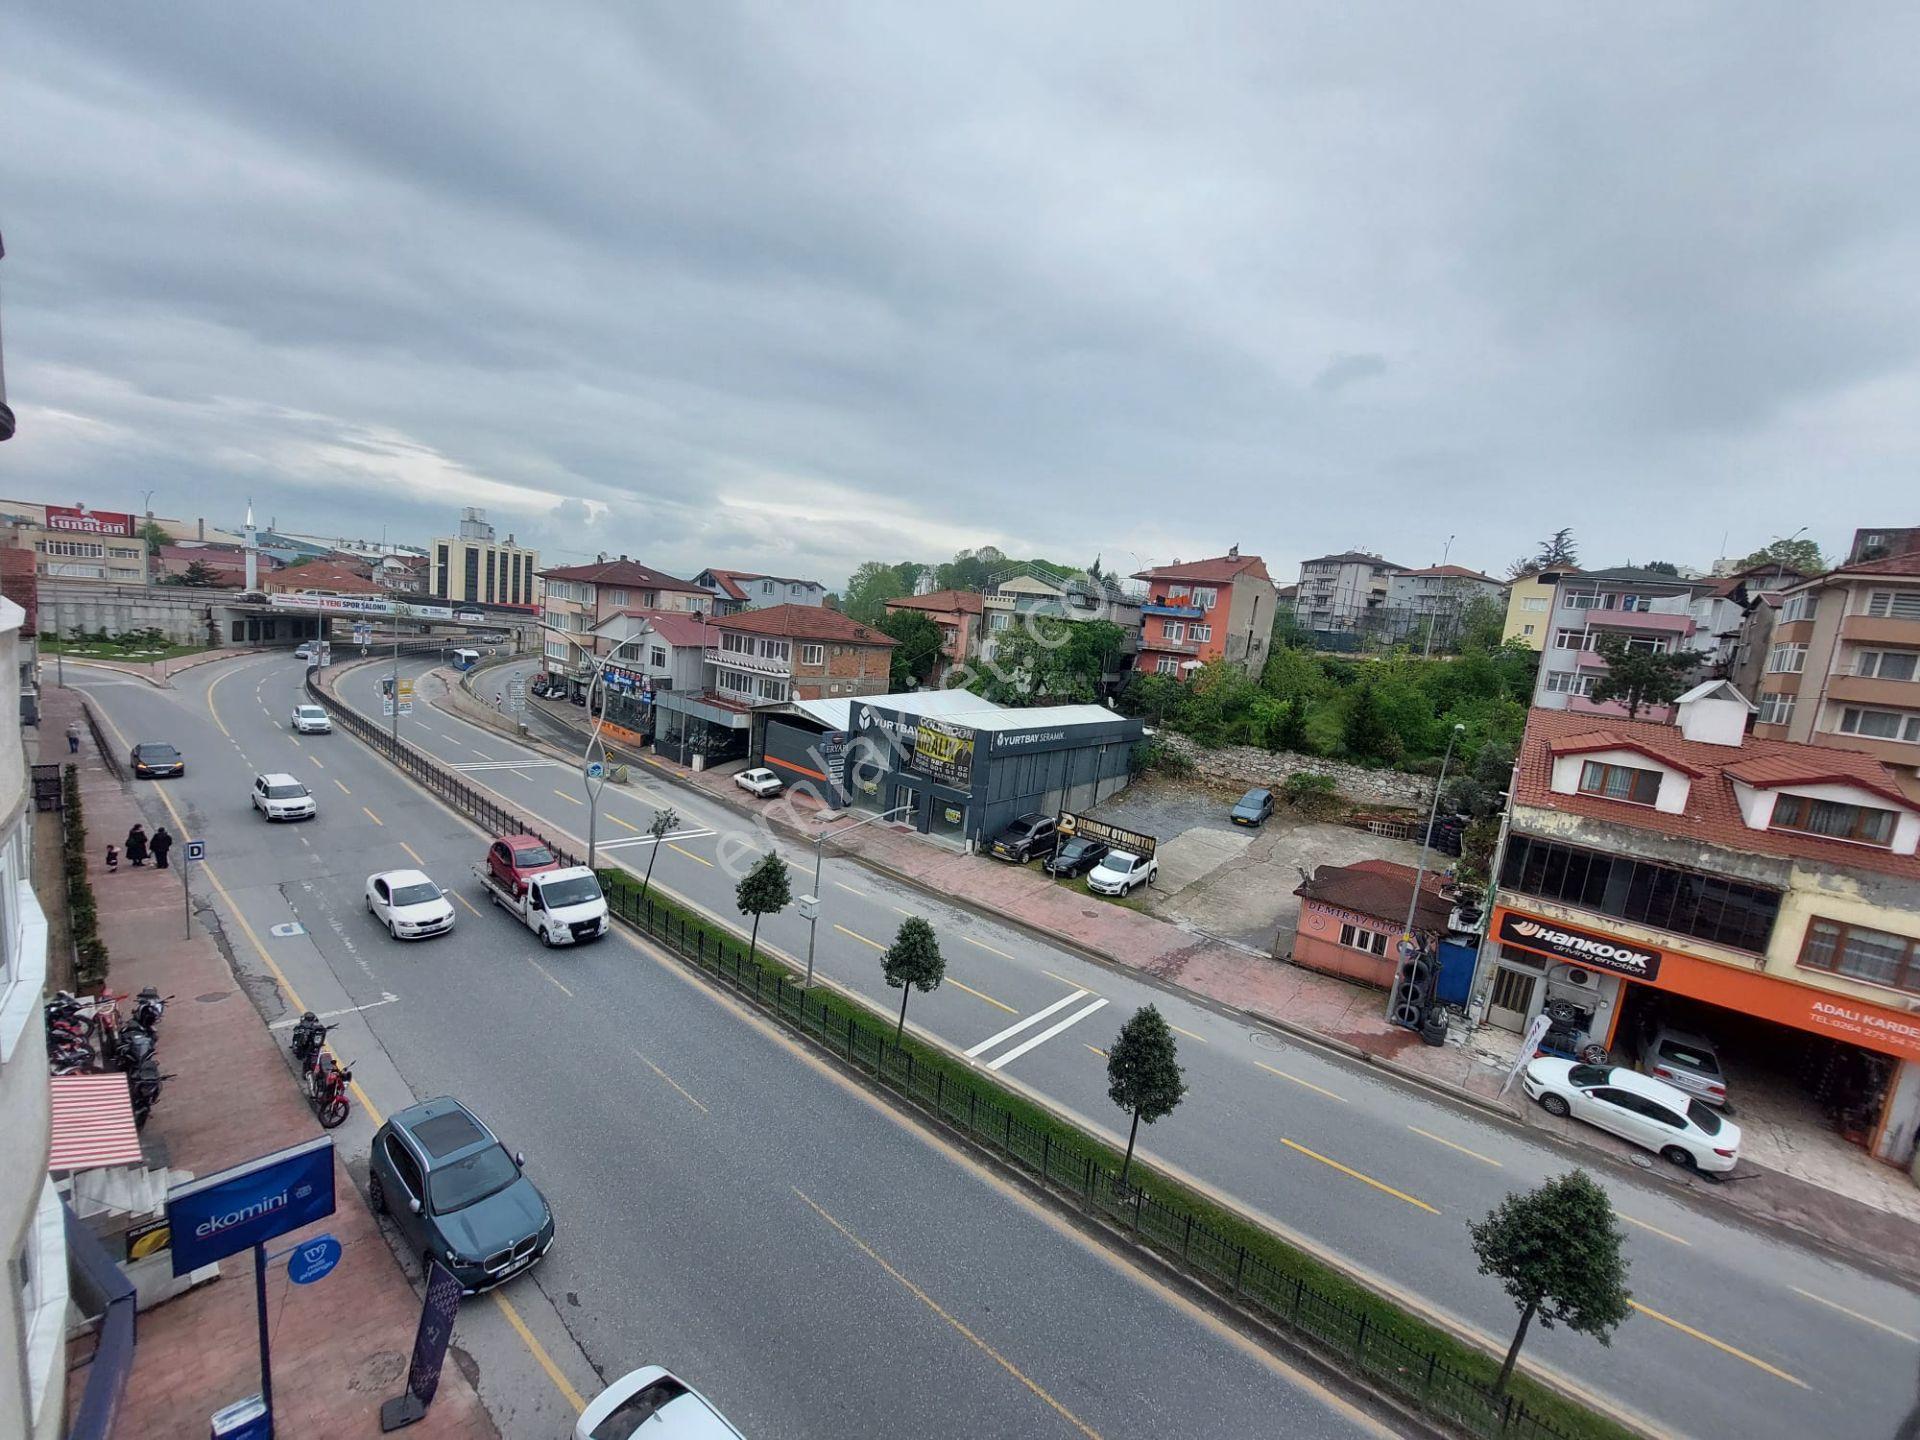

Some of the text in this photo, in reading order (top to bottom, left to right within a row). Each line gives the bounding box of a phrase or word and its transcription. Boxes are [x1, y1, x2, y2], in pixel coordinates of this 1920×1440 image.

[49, 513, 125, 534] tunatan
[1004, 733, 1040, 746] YURTBAY
[189, 846, 202, 857] D
[1553, 944, 1647, 975] driving emotion
[1812, 1001, 1860, 1022] ADALI
[194, 1188, 288, 1238] ekomini
